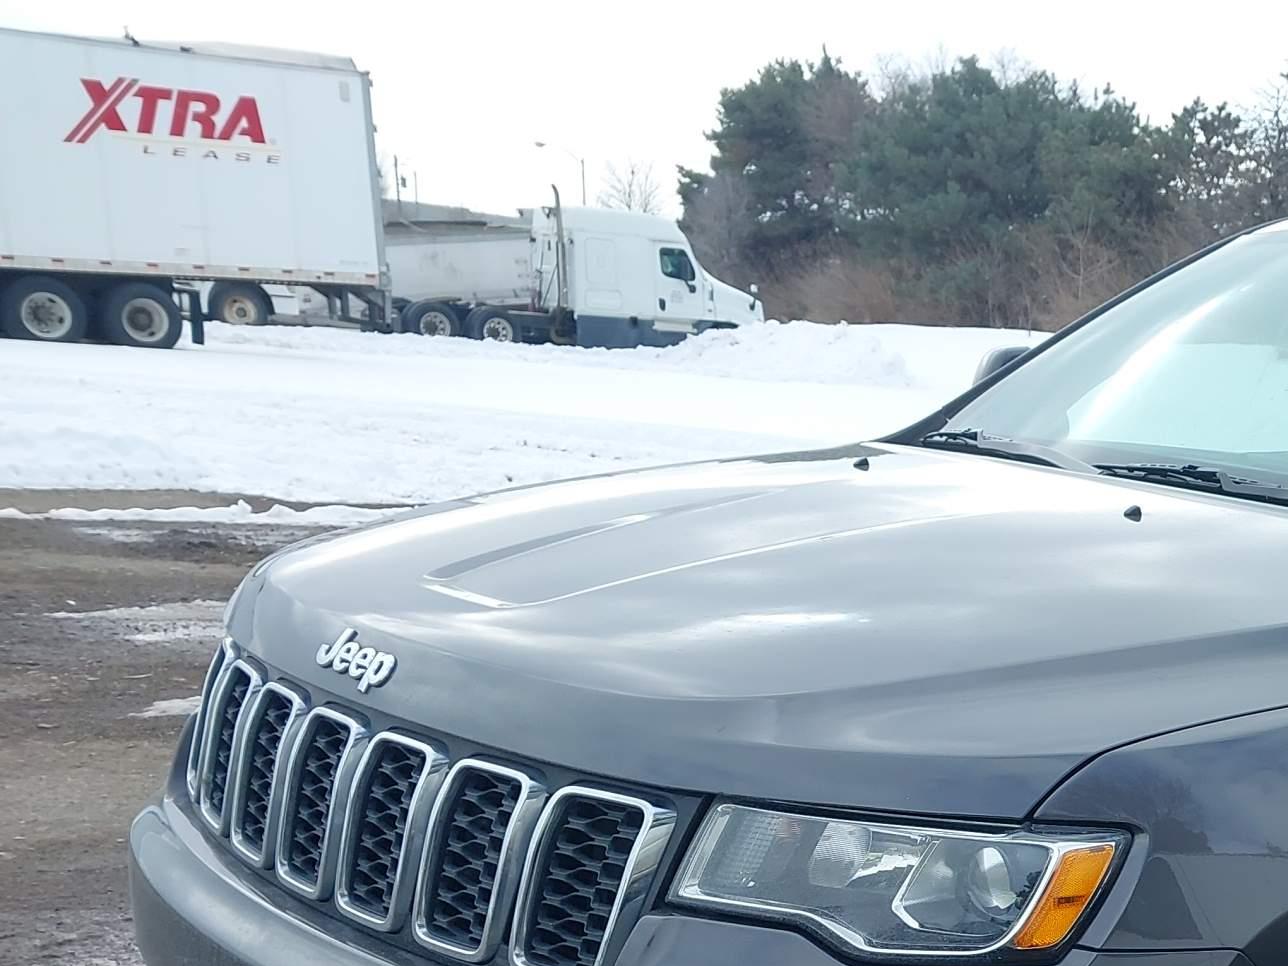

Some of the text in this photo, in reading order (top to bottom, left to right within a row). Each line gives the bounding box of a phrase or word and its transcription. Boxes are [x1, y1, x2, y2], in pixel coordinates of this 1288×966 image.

[64, 77, 266, 144] XTRA
[142, 145, 282, 164] LEASE
[316, 627, 398, 694] Jeep
